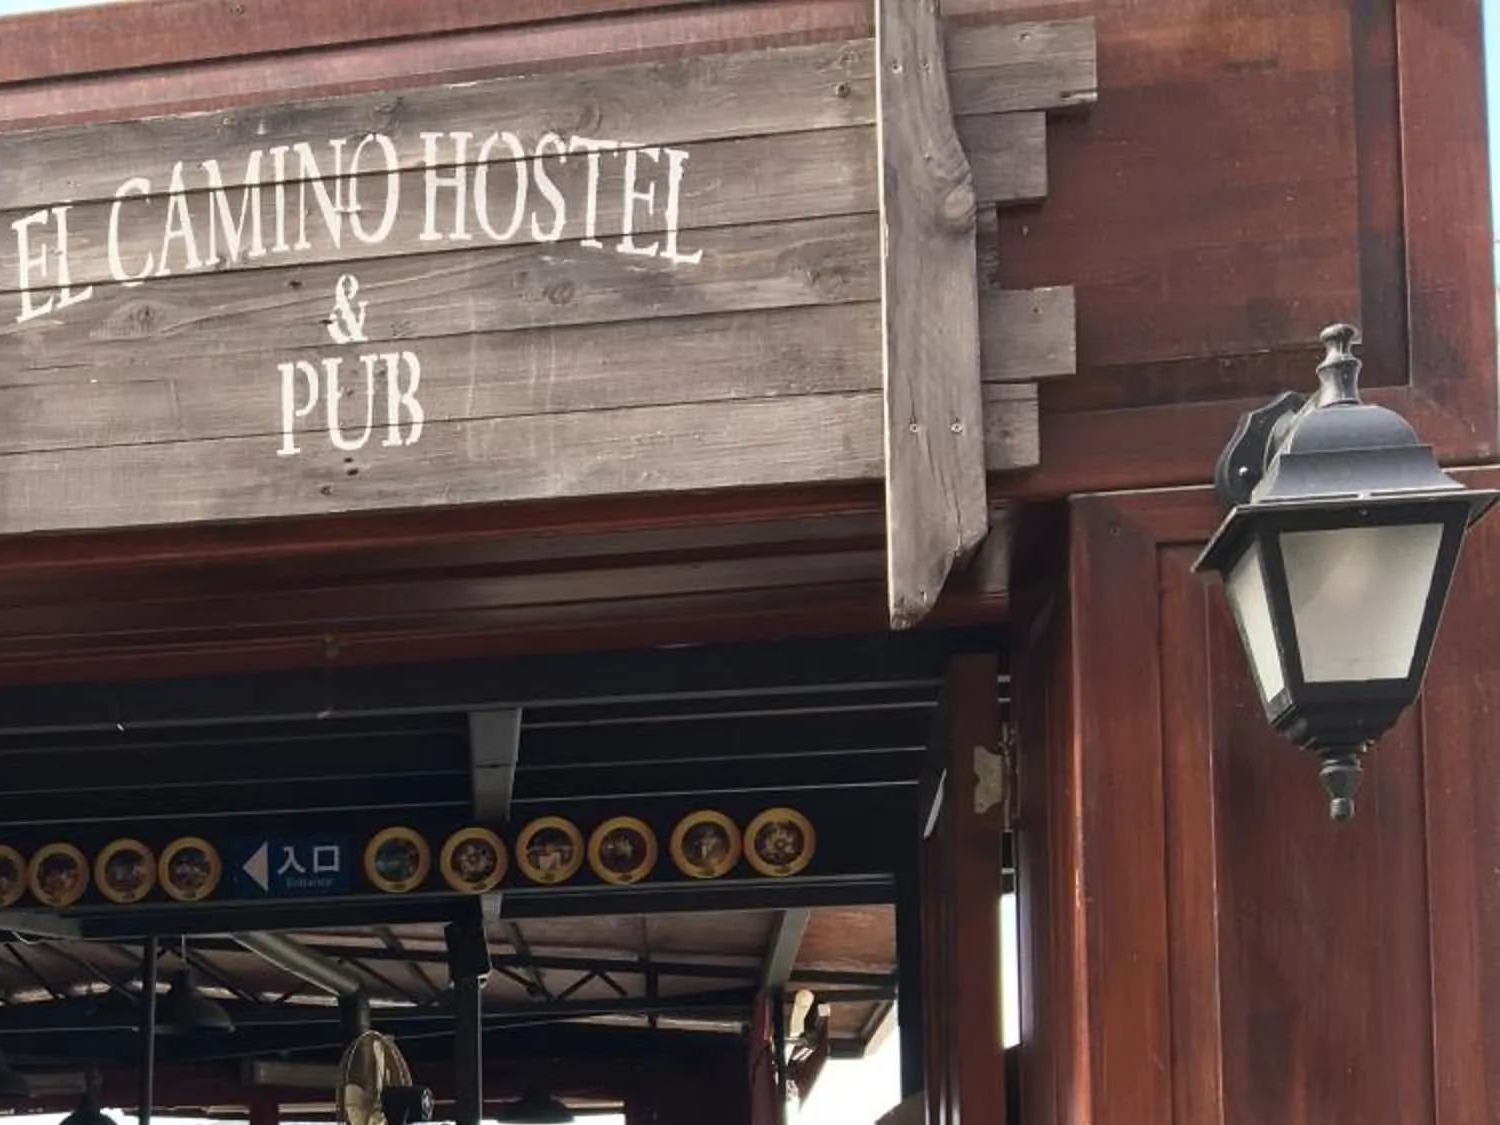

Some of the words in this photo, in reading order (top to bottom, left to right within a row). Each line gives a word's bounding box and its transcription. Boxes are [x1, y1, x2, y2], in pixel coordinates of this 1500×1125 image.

[11, 203, 93, 325] EL
[107, 133, 401, 287] CAMINO
[417, 130, 704, 264] HOSTEL
[326, 273, 369, 345] &
[276, 350, 425, 457] PUB
[277, 845, 340, 875] 入口
